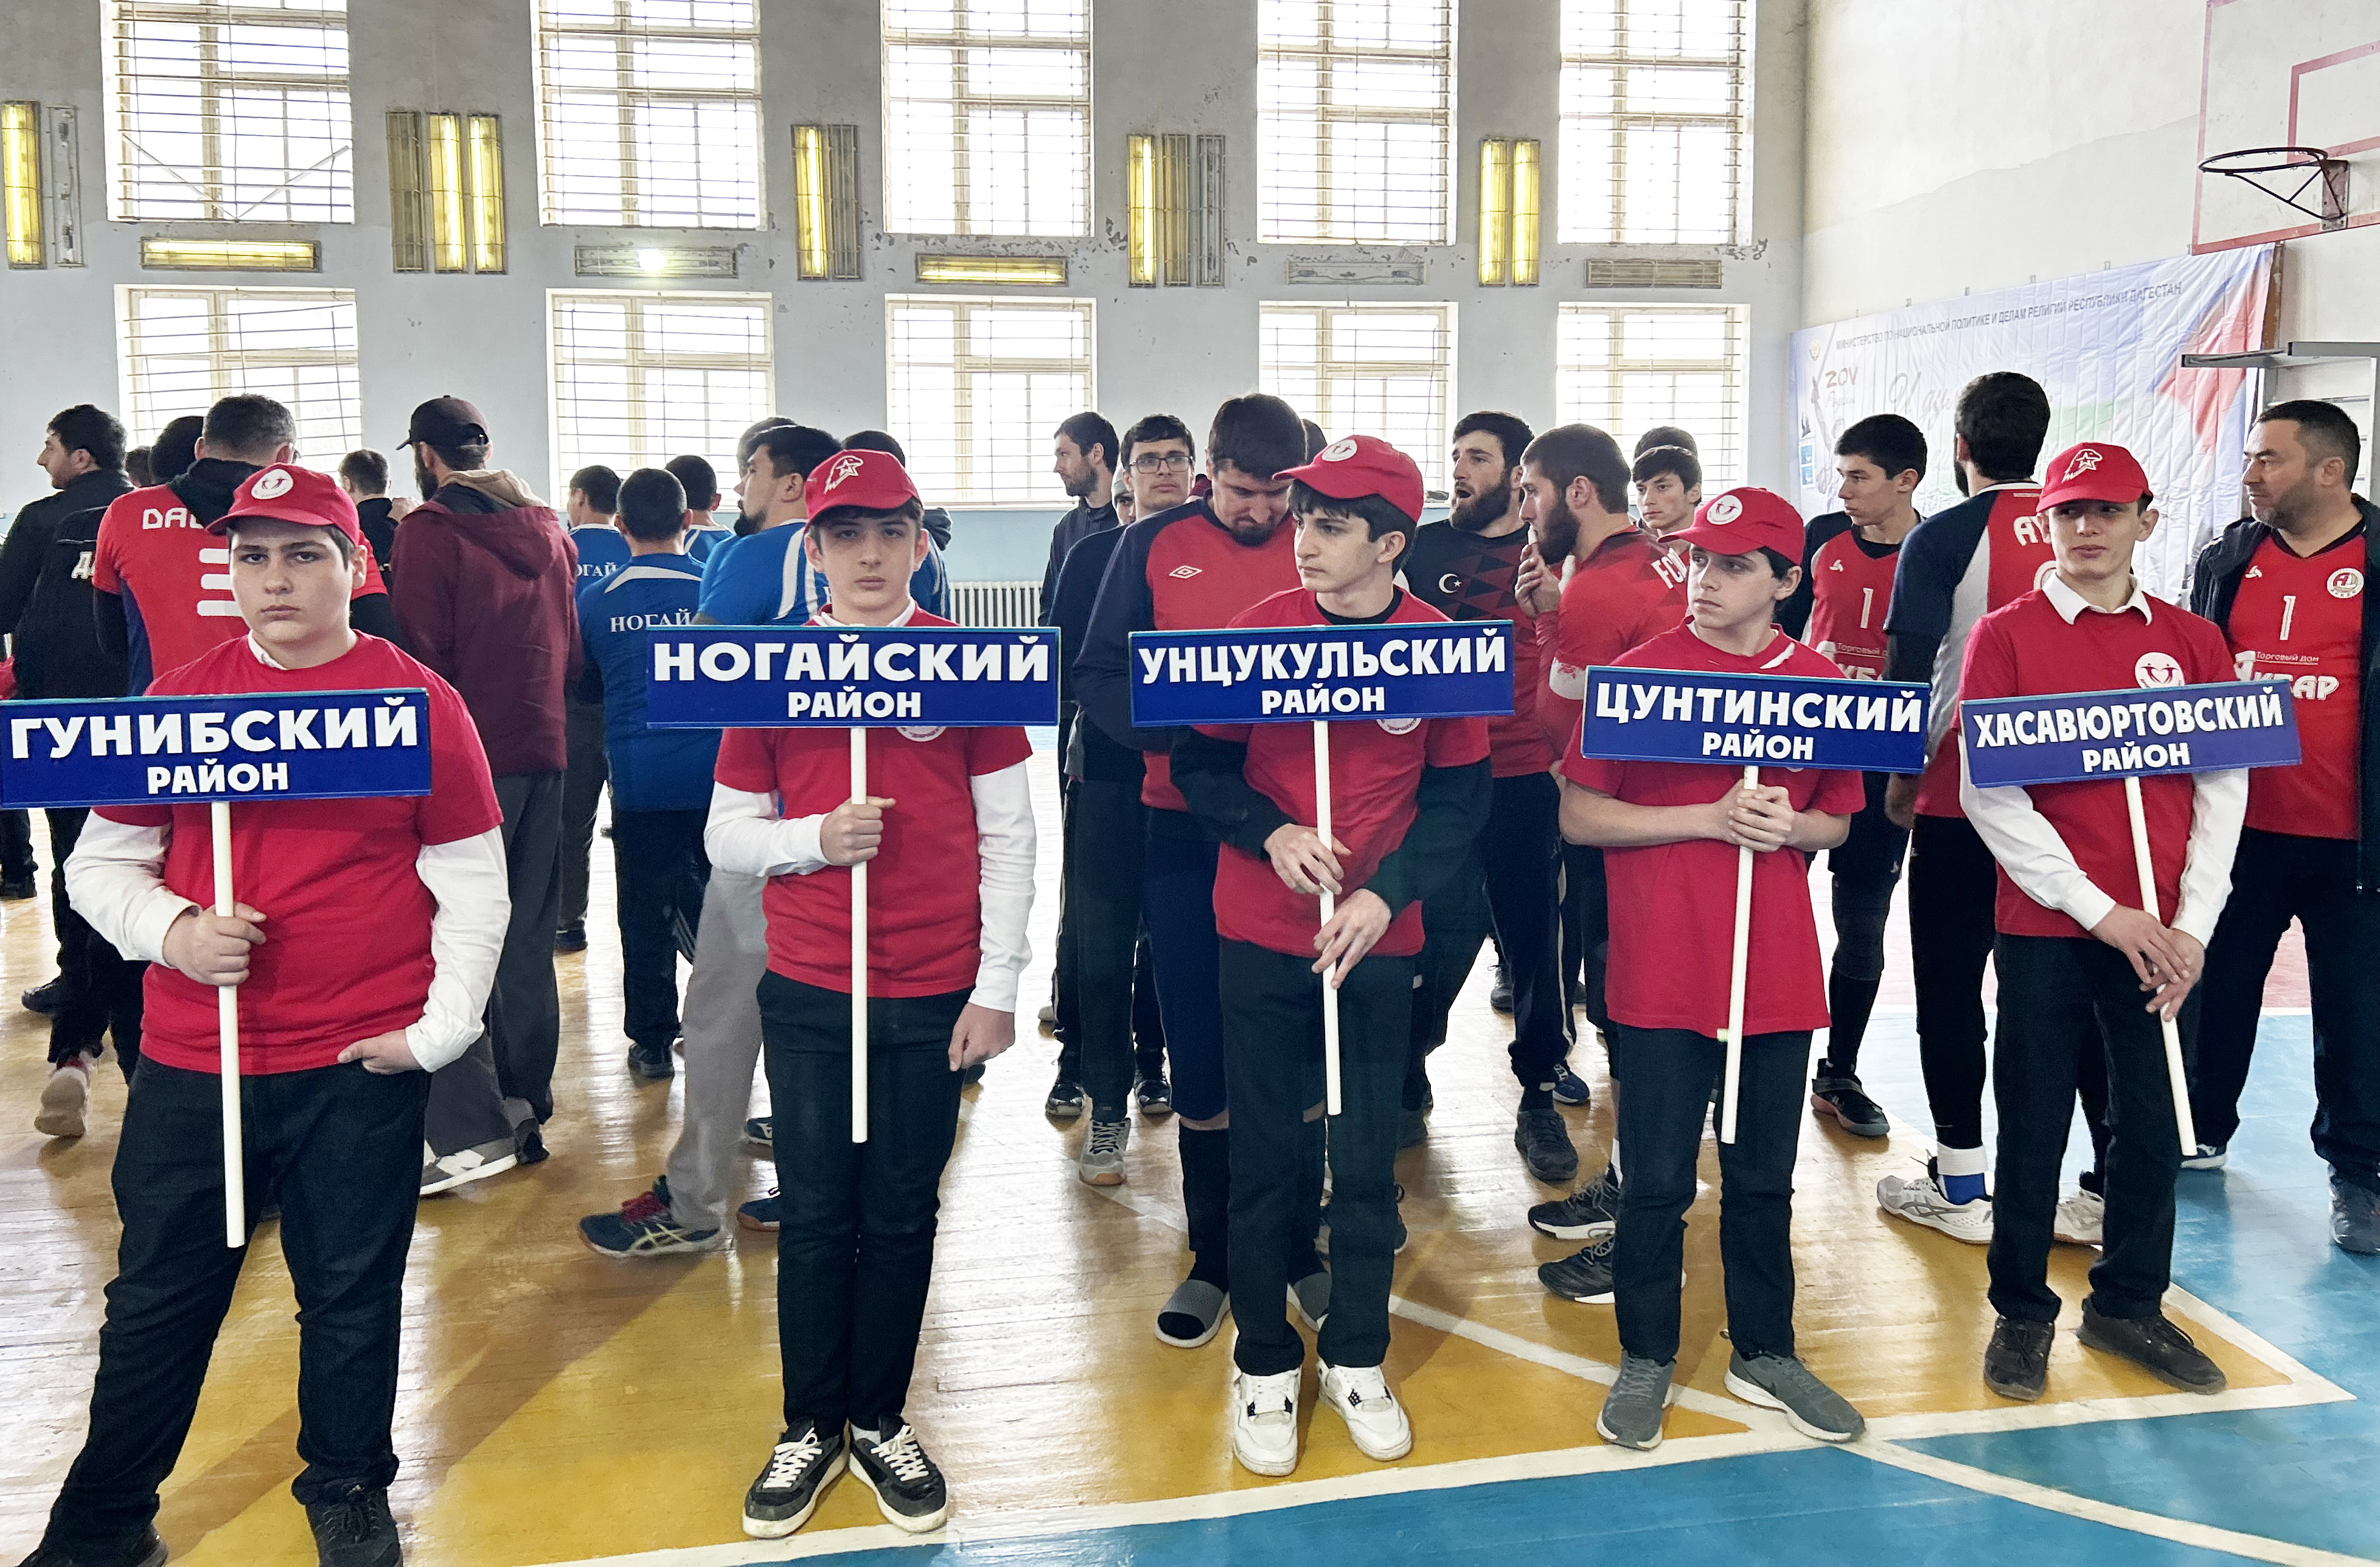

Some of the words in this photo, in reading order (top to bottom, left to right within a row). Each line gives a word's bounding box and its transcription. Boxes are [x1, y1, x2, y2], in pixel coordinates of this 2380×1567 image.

[1836, 332, 1883, 350] МИНИСТЕРСТВО
[1884, 330, 1893, 341] ПО
[1895, 319, 1950, 339] НАЦИОНАЛЬНОЙ
[1951, 313, 1991, 330] ПОЛИТИКЕ
[1991, 312, 1997, 324] И
[1999, 308, 2026, 324] ДЕЛАМ
[2028, 299, 2067, 318] РЕЛИГИЙ
[2068, 291, 2128, 312] РЕСПУБЛИКИ
[2129, 282, 2182, 304] ДАГЕСТАН
[1825, 367, 1858, 389] ZOV
[610, 608, 691, 633] НОГАЙ
[1860, 587, 1874, 629] 1
[2280, 595, 2296, 641] 1
[654, 634, 1048, 681] НОГАЙСКИЙ
[1138, 628, 1505, 687] УНЦУКУЛЬСКИЙ
[2256, 651, 2298, 662] Торговый
[788, 686, 921, 718] РАЙОН
[1261, 683, 1385, 715] РАЙОН
[1596, 683, 1922, 732] ЦУНТИНСКИЙ
[1973, 687, 2284, 748] ХАСАВЮРТОВСКИЙ
[10, 697, 417, 759] ГУНИБСКИЙ
[1702, 729, 1814, 760] РАЙОН
[147, 758, 289, 795] РАЙОН
[2082, 741, 2191, 773] РАЙОН
